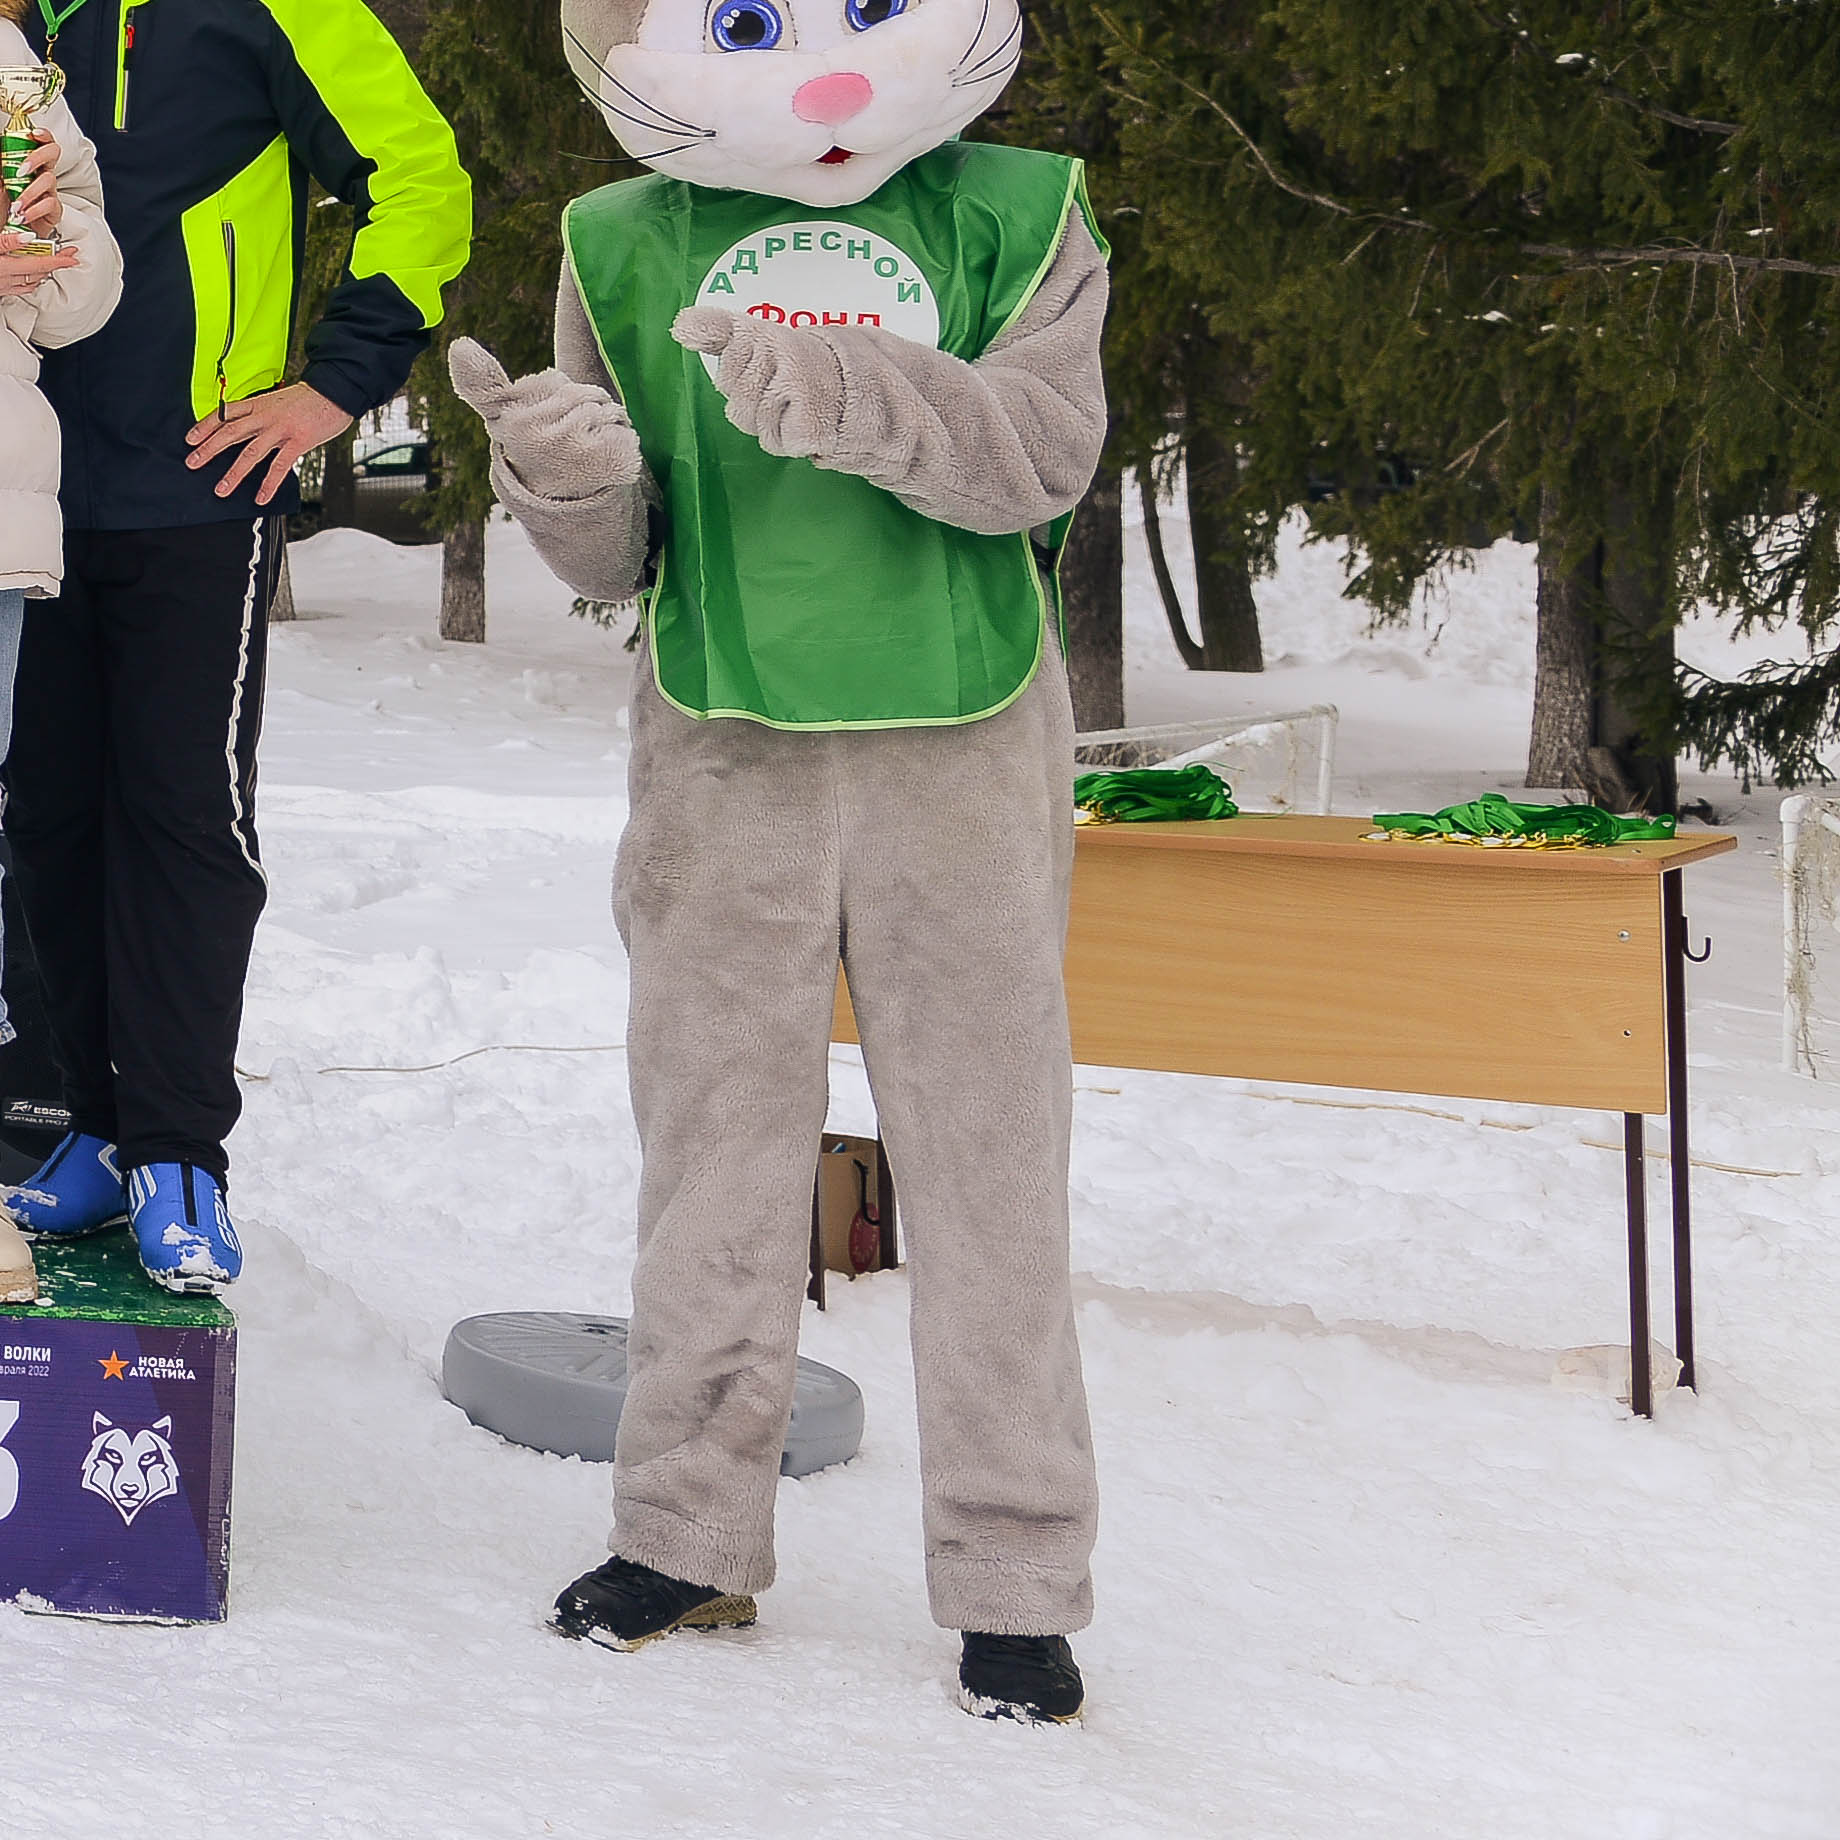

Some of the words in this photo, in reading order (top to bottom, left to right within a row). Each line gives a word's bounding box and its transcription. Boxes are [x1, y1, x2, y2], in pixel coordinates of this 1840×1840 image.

[707, 230, 922, 305] АДРЕСНОЙ
[4, 1345, 51, 1362] ВОЛКИ
[139, 1356, 184, 1368] НОВАЯ
[28, 1365, 49, 1377] 2022
[129, 1367, 196, 1380] АТЛЕТИКА
